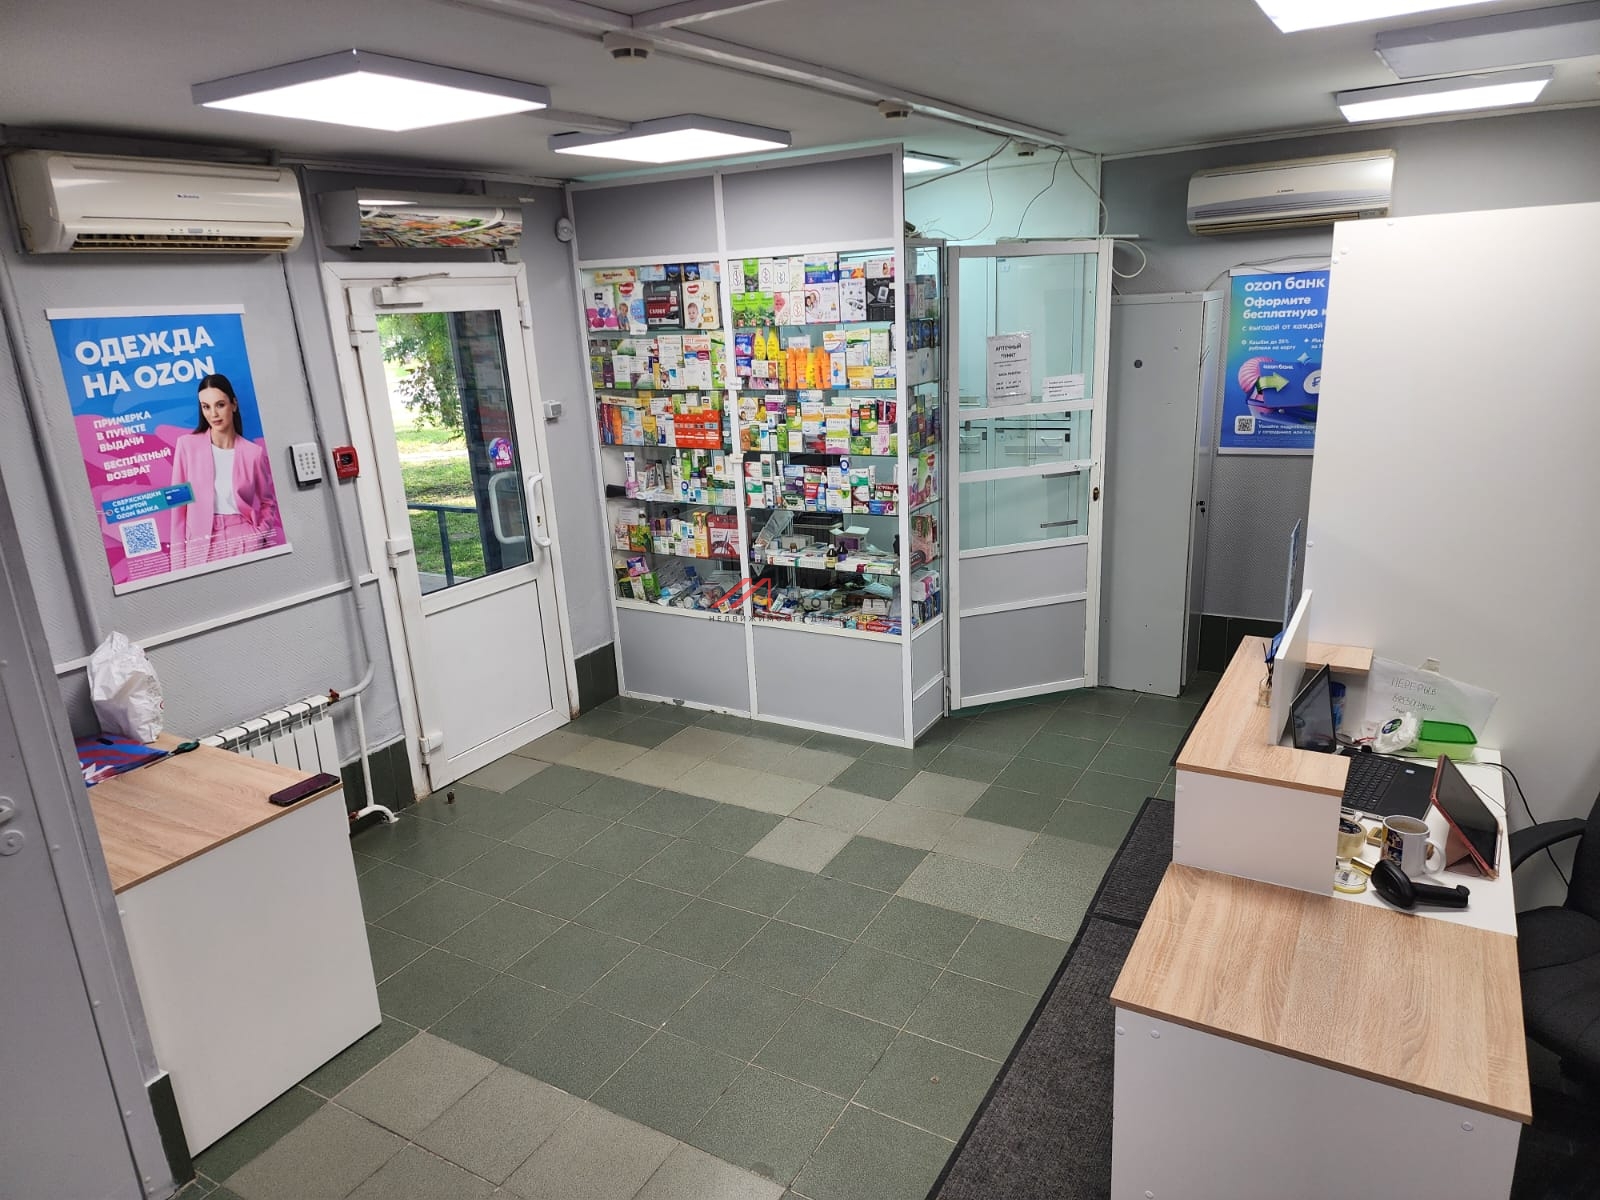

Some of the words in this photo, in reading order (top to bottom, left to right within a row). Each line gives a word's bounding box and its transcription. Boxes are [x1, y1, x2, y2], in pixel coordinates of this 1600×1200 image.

[1244, 280, 1282, 292] ozon
[1285, 276, 1326, 290] банк
[1244, 297, 1311, 309] Оформите
[1243, 309, 1318, 320] бесплатную
[75, 326, 215, 367] ОДЕЖДА
[82, 370, 131, 399] НА
[134, 356, 215, 389] OZON
[93, 410, 152, 429] ПРИМЕРКА
[96, 432, 105, 441] В
[106, 424, 147, 439] ПУНКТЕ
[99, 436, 145, 453] ВЫДАЧИ
[103, 447, 171, 470] БЕСПЛАТНЫЙ
[106, 465, 151, 482] ВОЗВРАТ
[112, 490, 162, 507] СВЕРХСКИДКИ
[120, 500, 148, 512] КАРТОЙ
[116, 511, 136, 520] OZON
[136, 505, 159, 515] БАНКА
